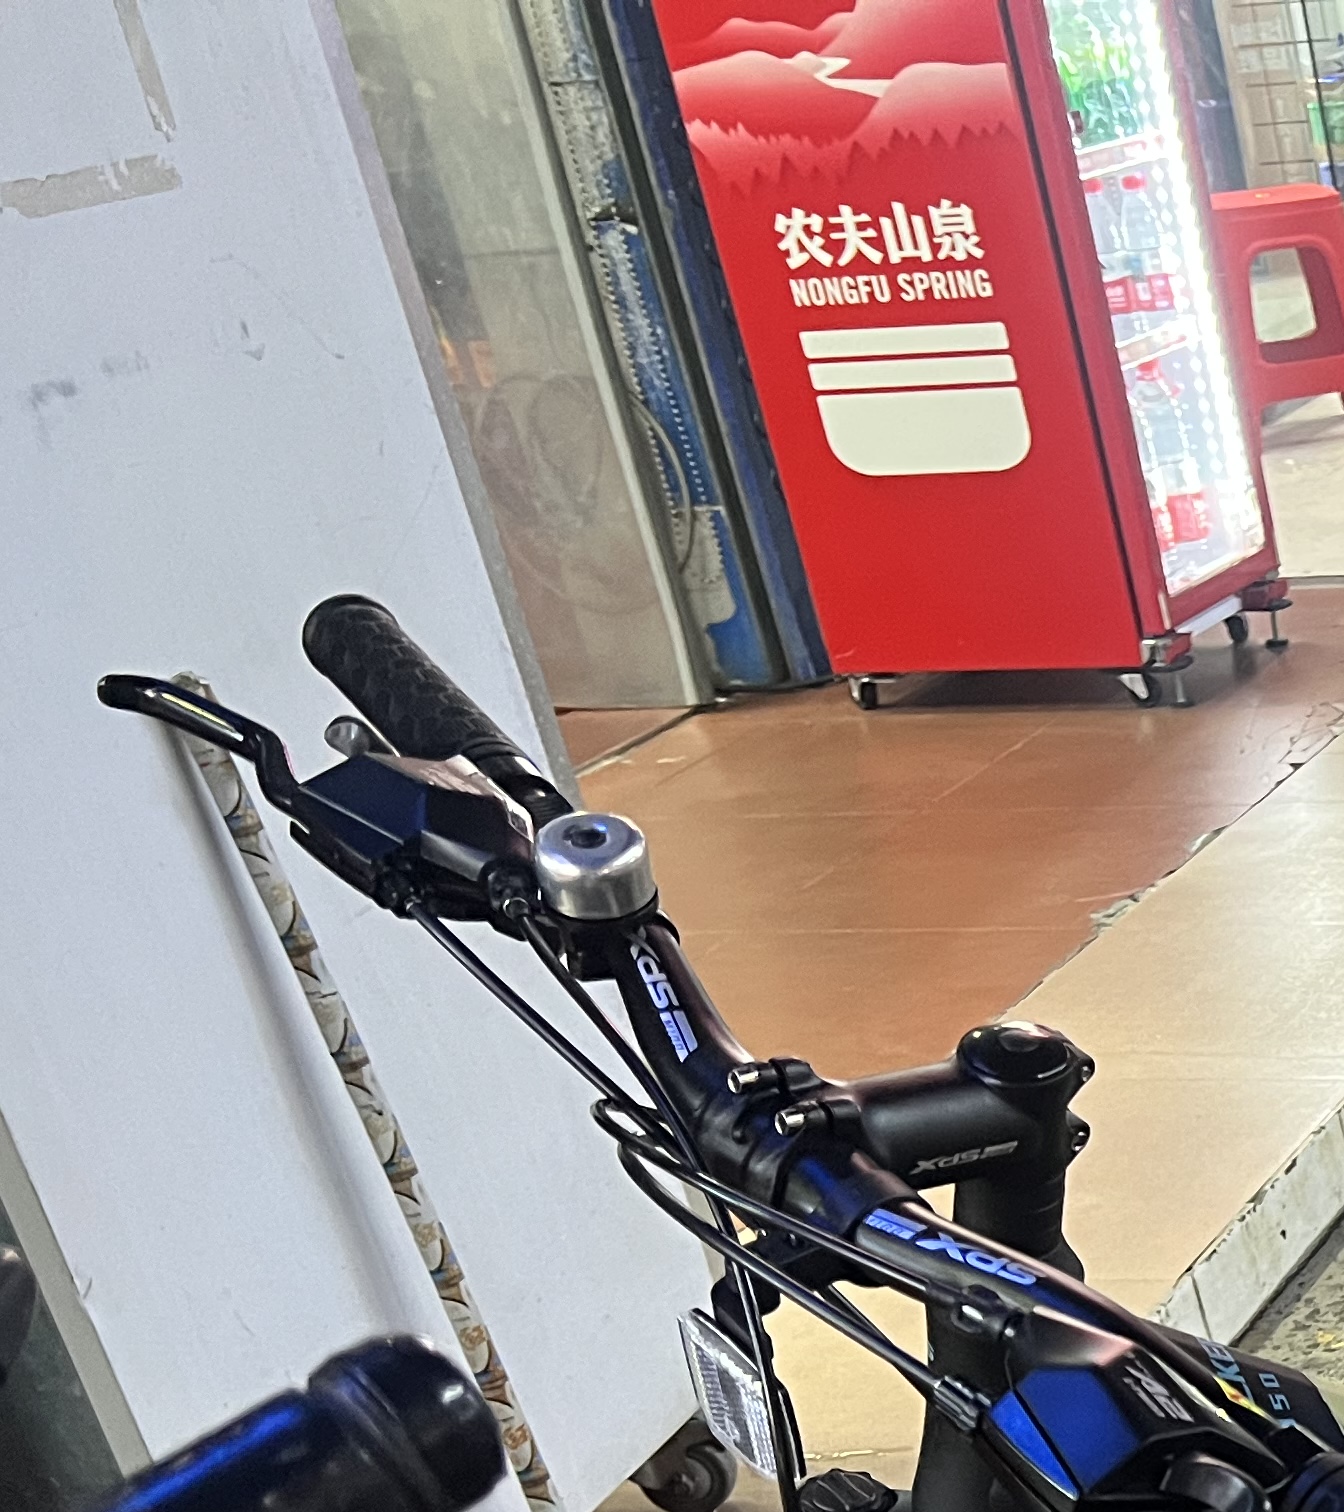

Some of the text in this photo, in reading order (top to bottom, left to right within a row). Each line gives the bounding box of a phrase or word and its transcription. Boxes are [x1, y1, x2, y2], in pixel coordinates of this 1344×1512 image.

[773, 198, 985, 270] 农夫山泉
[788, 268, 995, 308] NONGFU SPRING
